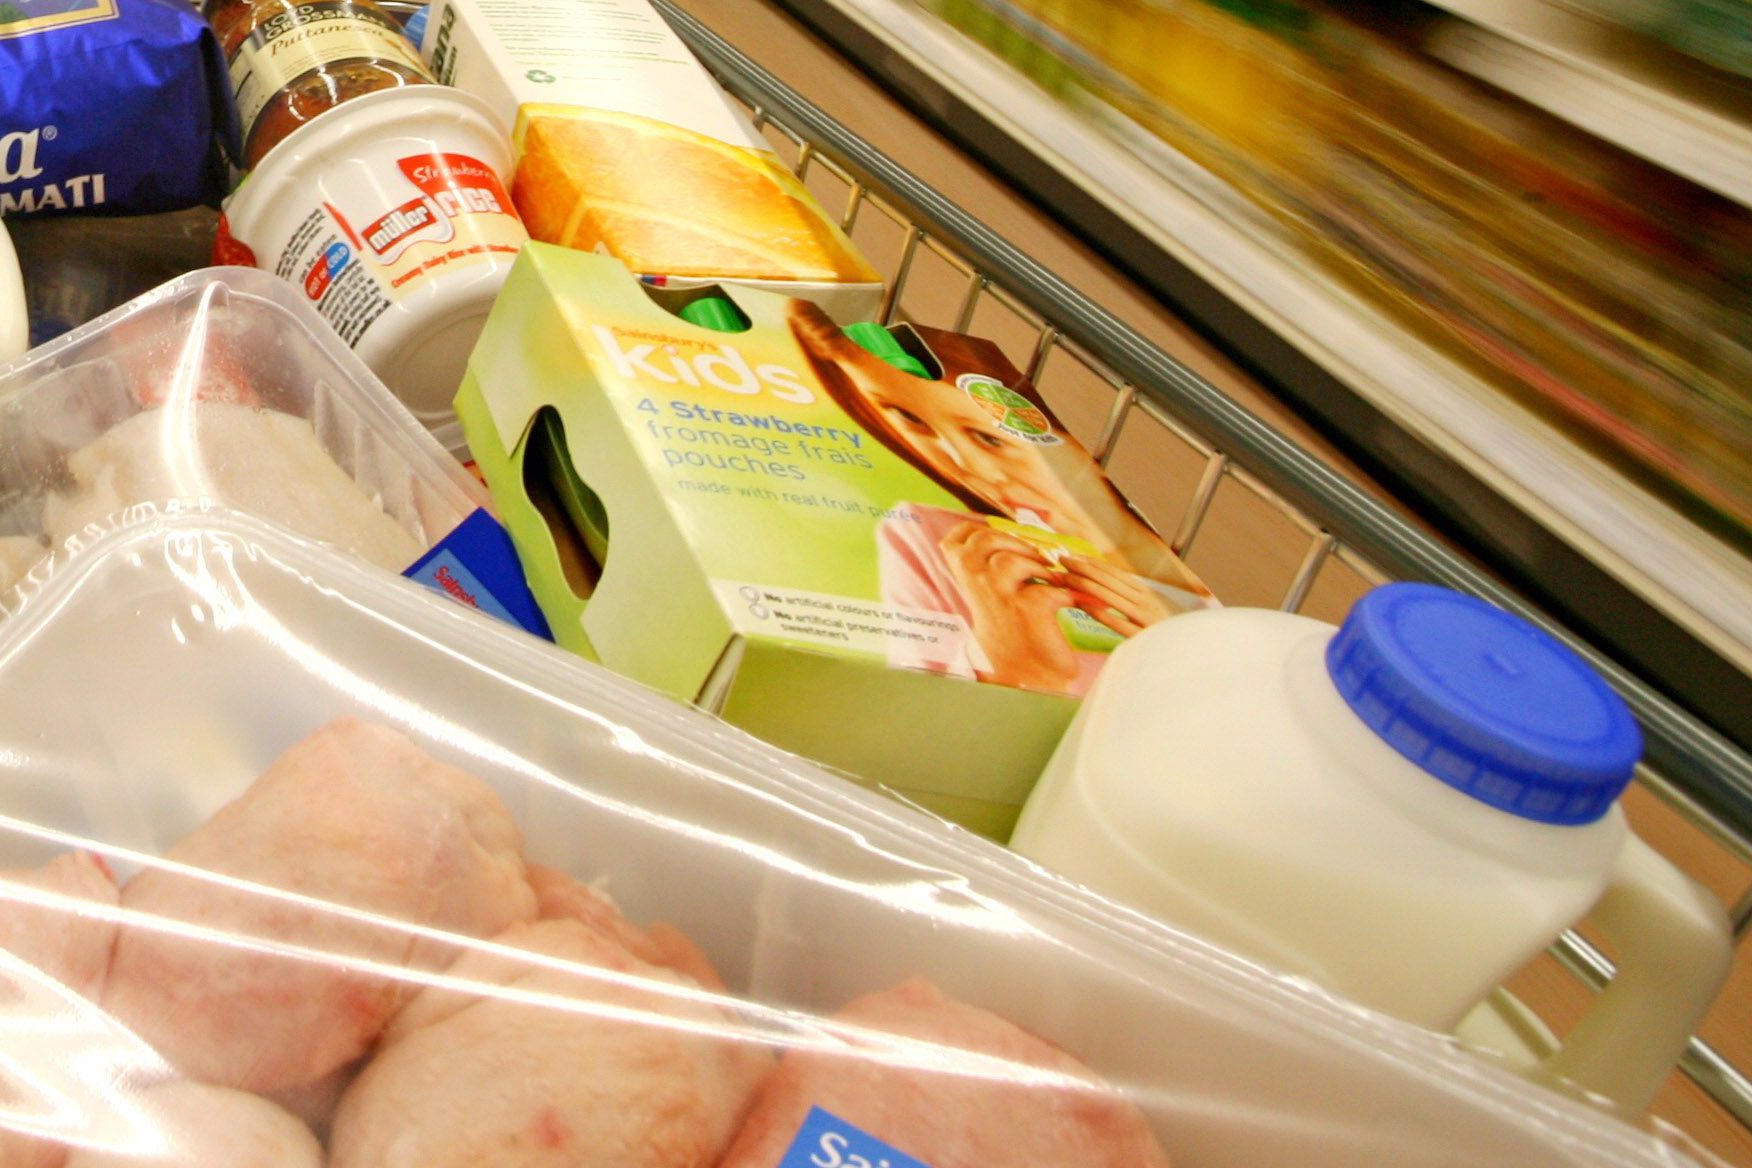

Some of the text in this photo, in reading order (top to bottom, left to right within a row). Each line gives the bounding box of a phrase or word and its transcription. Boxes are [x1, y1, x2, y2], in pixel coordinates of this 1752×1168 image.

[368, 204, 429, 252] müller
[434, 187, 503, 219] rice
[593, 324, 816, 405] kids
[637, 398, 862, 449] 4 Strawberry
[647, 420, 873, 469] fromage frais
[663, 448, 806, 481] pouches
[678, 480, 732, 495] made
[737, 484, 778, 500] with
[783, 491, 818, 506] real
[822, 496, 863, 513] fruit
[764, 592, 783, 604] No
[785, 595, 834, 611] artificial
[773, 609, 792, 620] No
[795, 613, 843, 629] artificial
